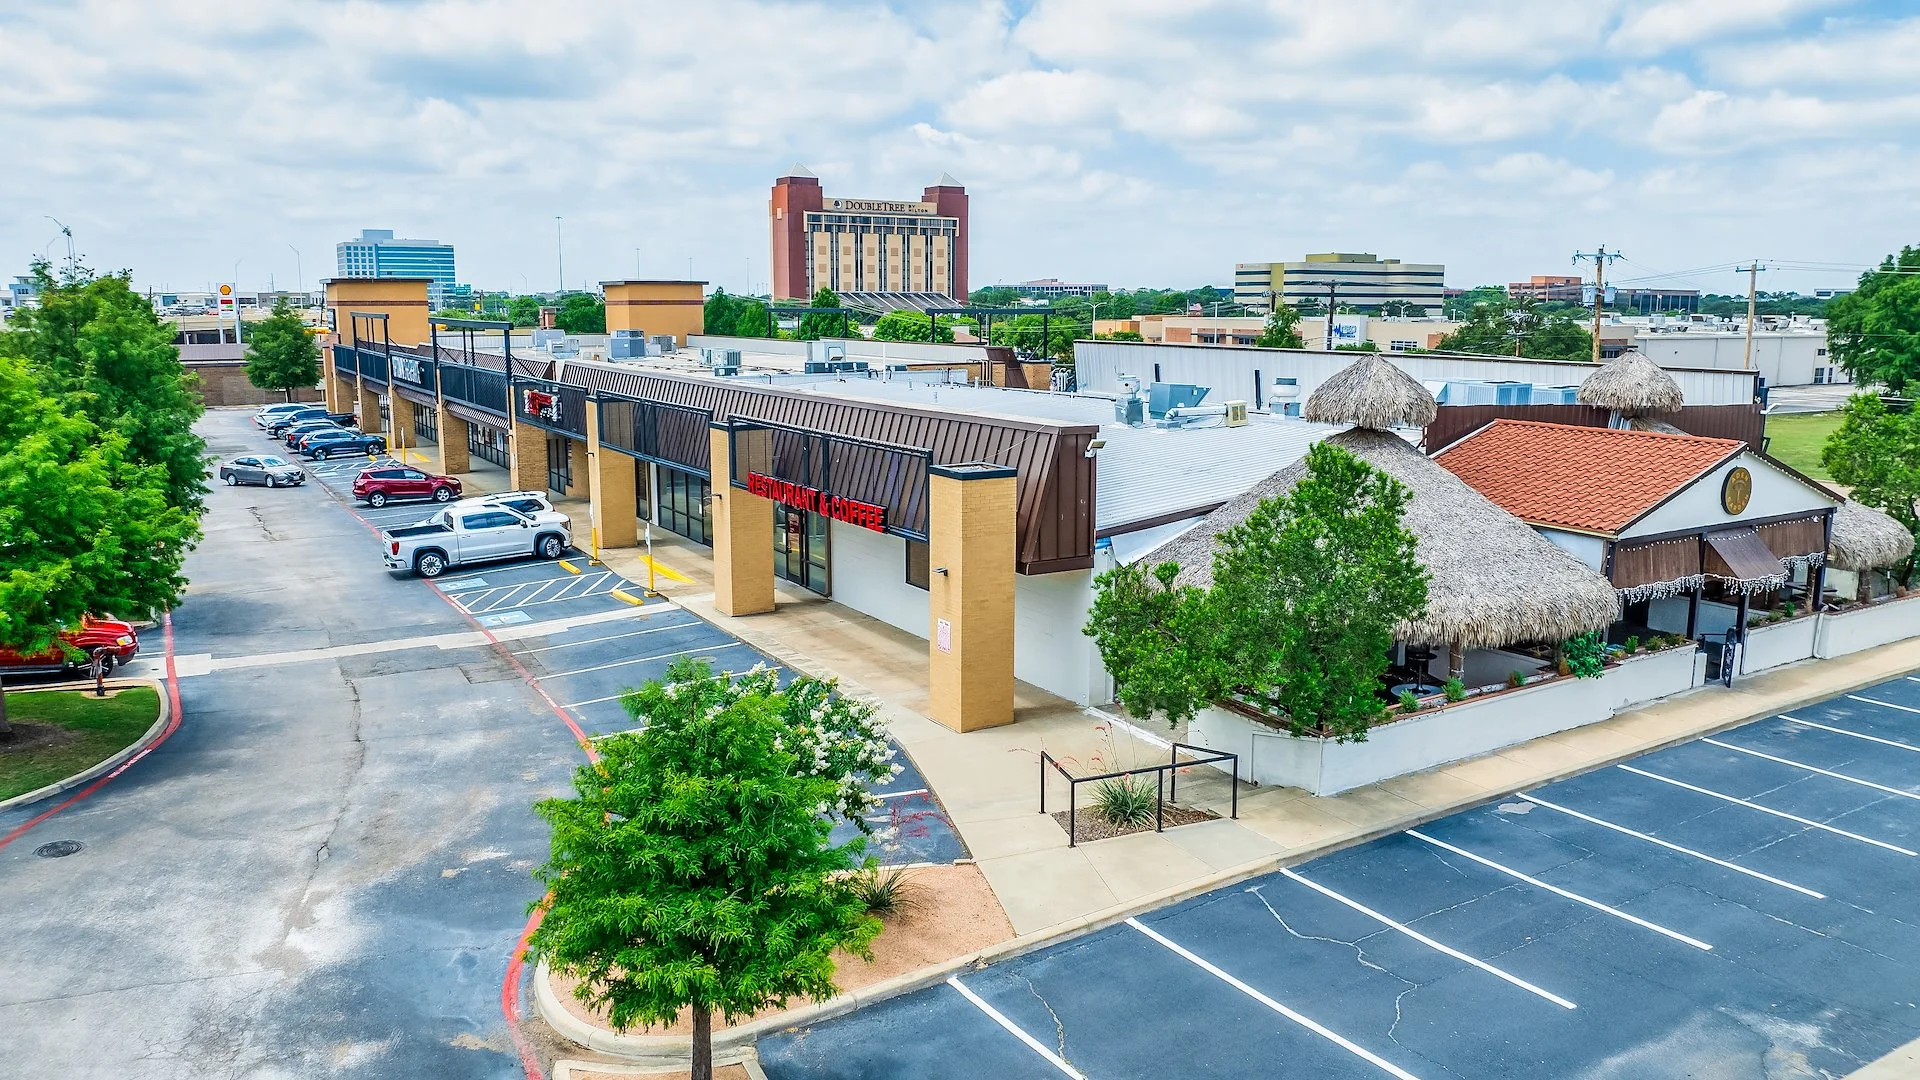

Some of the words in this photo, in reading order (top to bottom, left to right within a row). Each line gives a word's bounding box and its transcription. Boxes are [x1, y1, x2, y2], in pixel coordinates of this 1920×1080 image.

[747, 471, 818, 512] RESTAURANT
[819, 491, 830, 517] &
[831, 495, 887, 533] COFFEE
